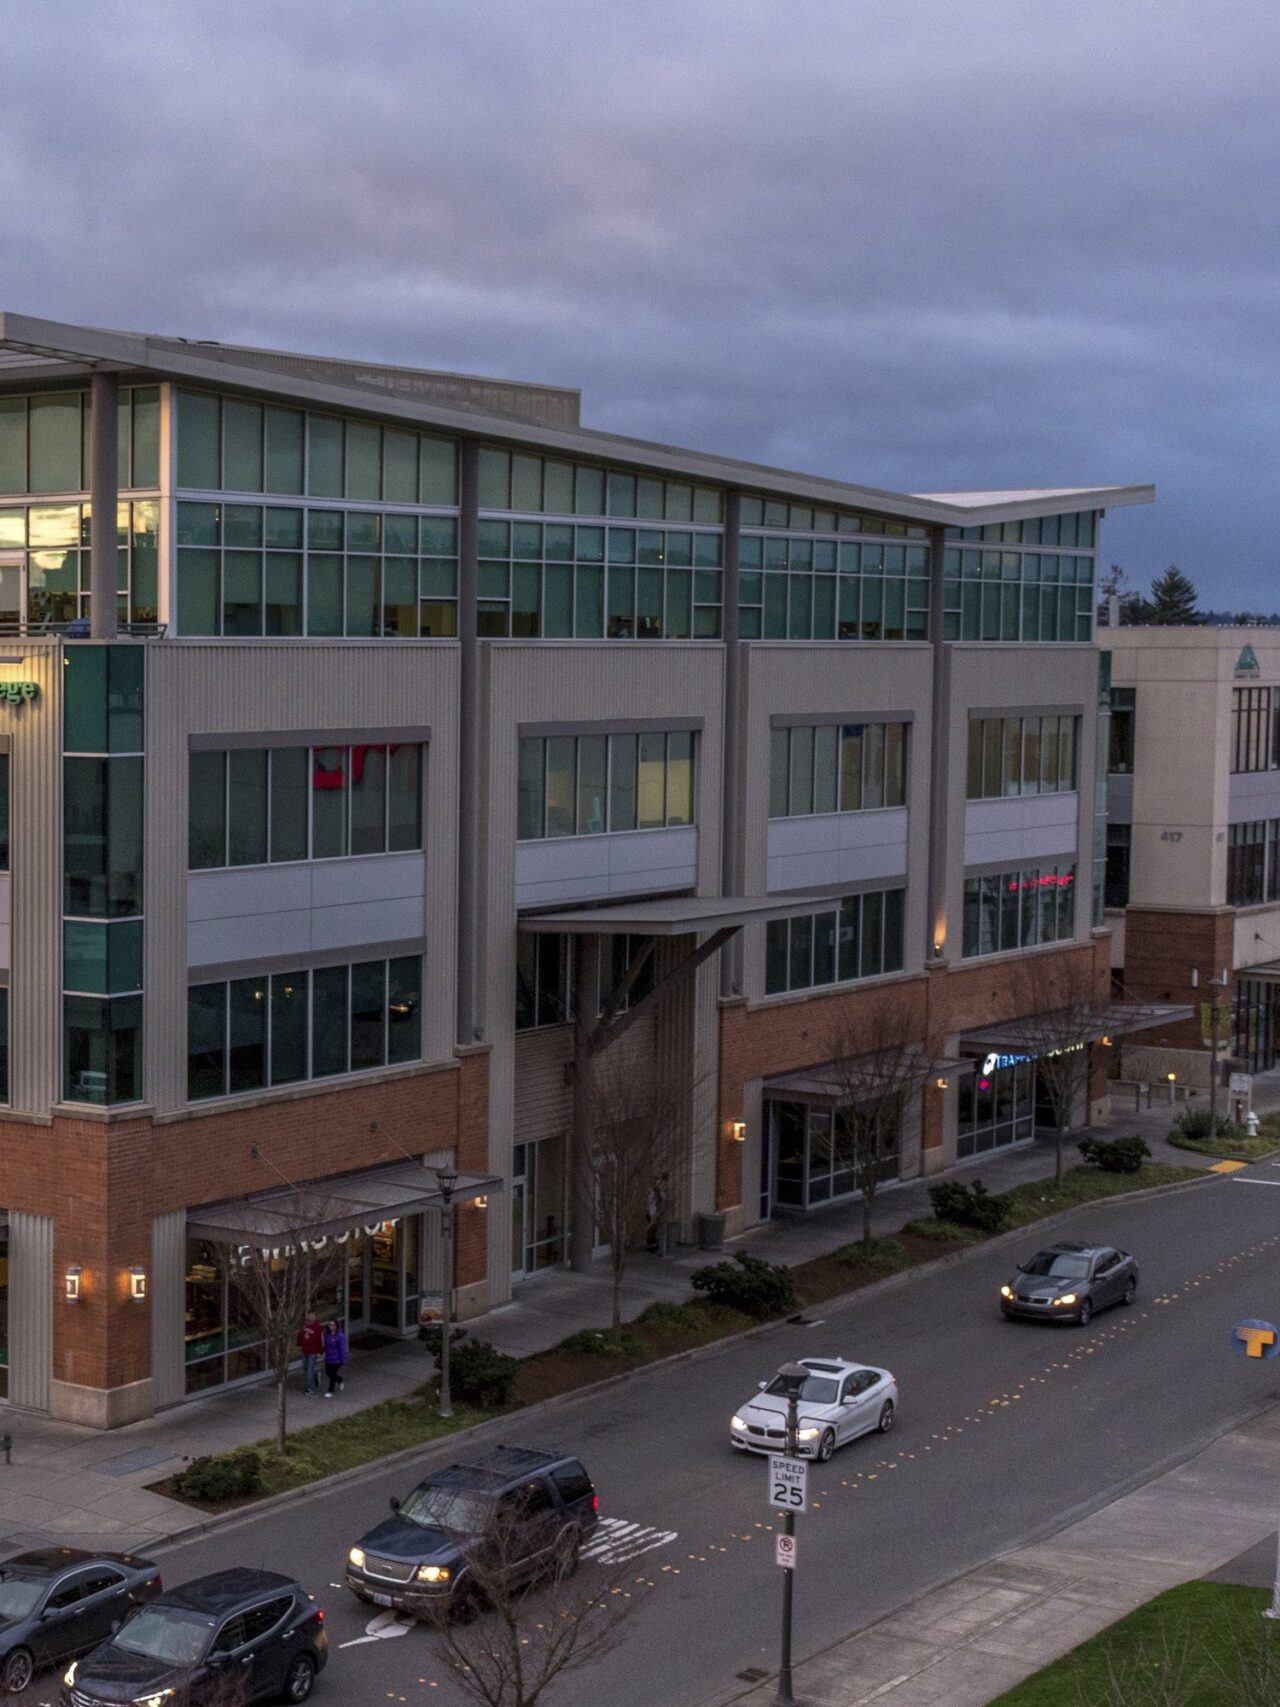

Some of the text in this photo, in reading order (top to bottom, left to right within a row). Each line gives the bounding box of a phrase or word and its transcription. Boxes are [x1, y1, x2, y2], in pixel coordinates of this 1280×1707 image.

[773, 1461, 805, 1475] SPEED
[775, 1473, 800, 1484] LIMIT
[773, 1483, 803, 1506] 25
